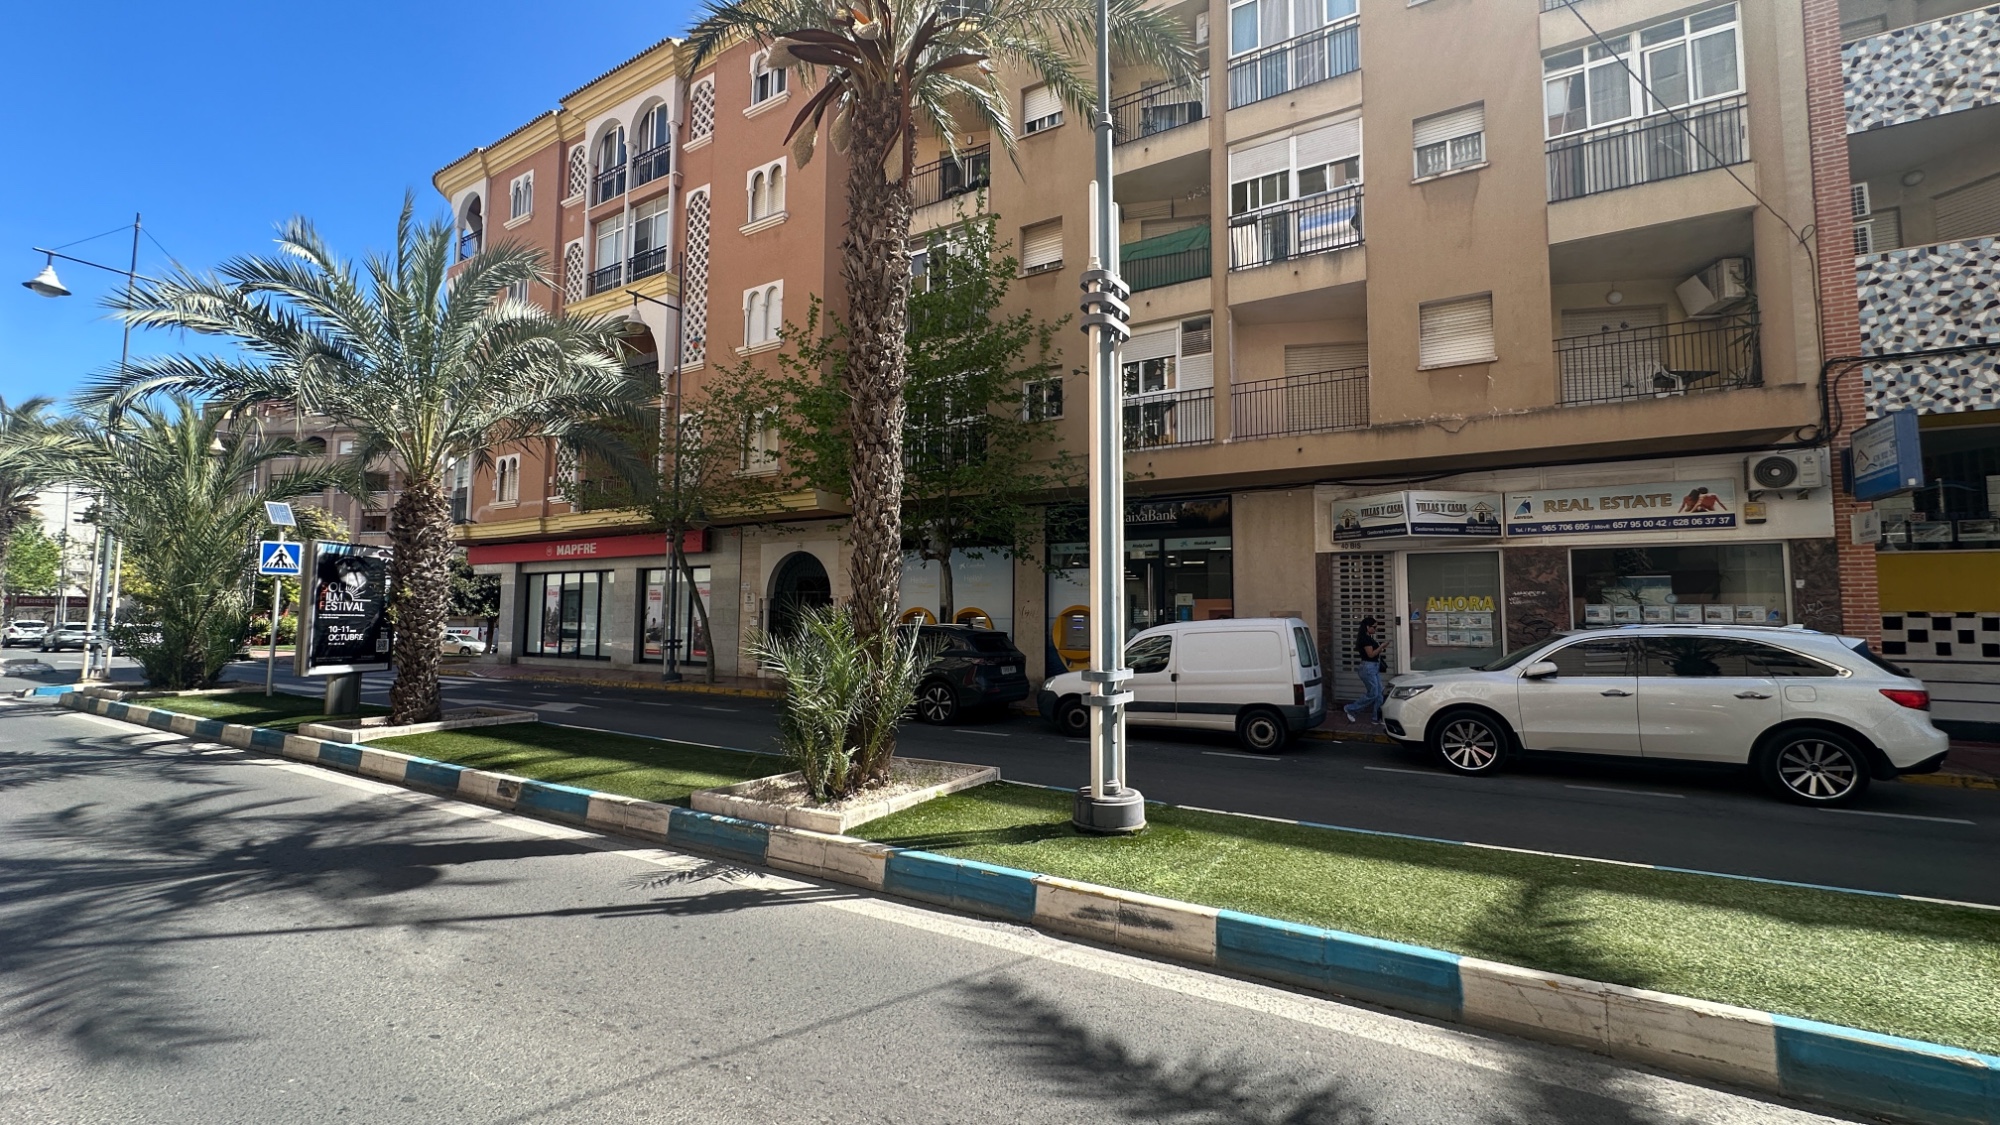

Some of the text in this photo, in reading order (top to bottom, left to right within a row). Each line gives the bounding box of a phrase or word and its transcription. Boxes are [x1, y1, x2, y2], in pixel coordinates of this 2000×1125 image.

[1415, 503, 1467, 513] VILLAS Y CASAS
[1543, 493, 1672, 513] REAL ESTATE
[1124, 508, 1177, 522] aixaBank
[1361, 507, 1380, 518] VILLAS
[1381, 505, 1386, 515] Y
[1387, 503, 1405, 514] CASAS
[1541, 524, 1557, 532] 965
[1574, 523, 1590, 531] 695
[1612, 521, 1628, 529] 657
[1643, 520, 1654, 528] 00
[1656, 519, 1667, 527] 42
[1705, 517, 1716, 525] 37
[1718, 516, 1730, 525] 37
[556, 543, 597, 556] MAPFRE
[319, 601, 365, 612] FESTIVAL
[1426, 595, 1495, 611] AHORA
